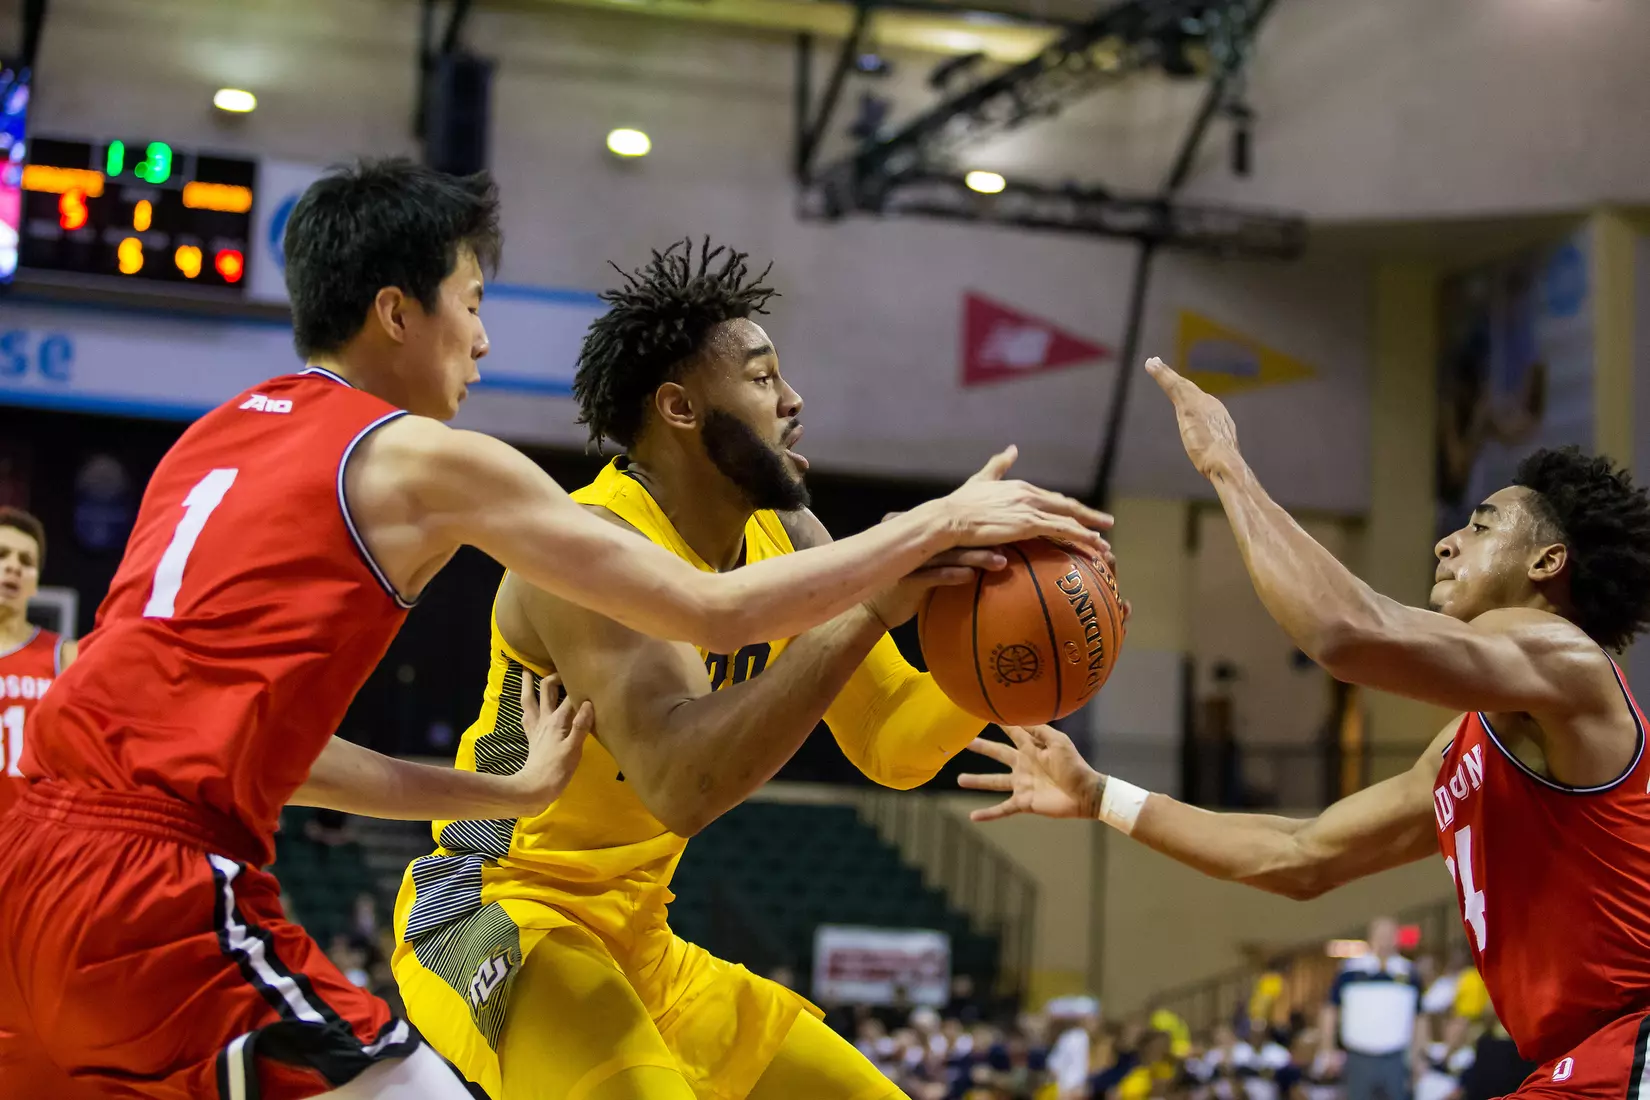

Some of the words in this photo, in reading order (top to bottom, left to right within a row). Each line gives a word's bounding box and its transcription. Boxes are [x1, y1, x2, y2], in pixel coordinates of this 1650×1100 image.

[143, 468, 238, 617] 1
[1055, 568, 1105, 701] PALDING
[0, 705, 26, 777] 1
